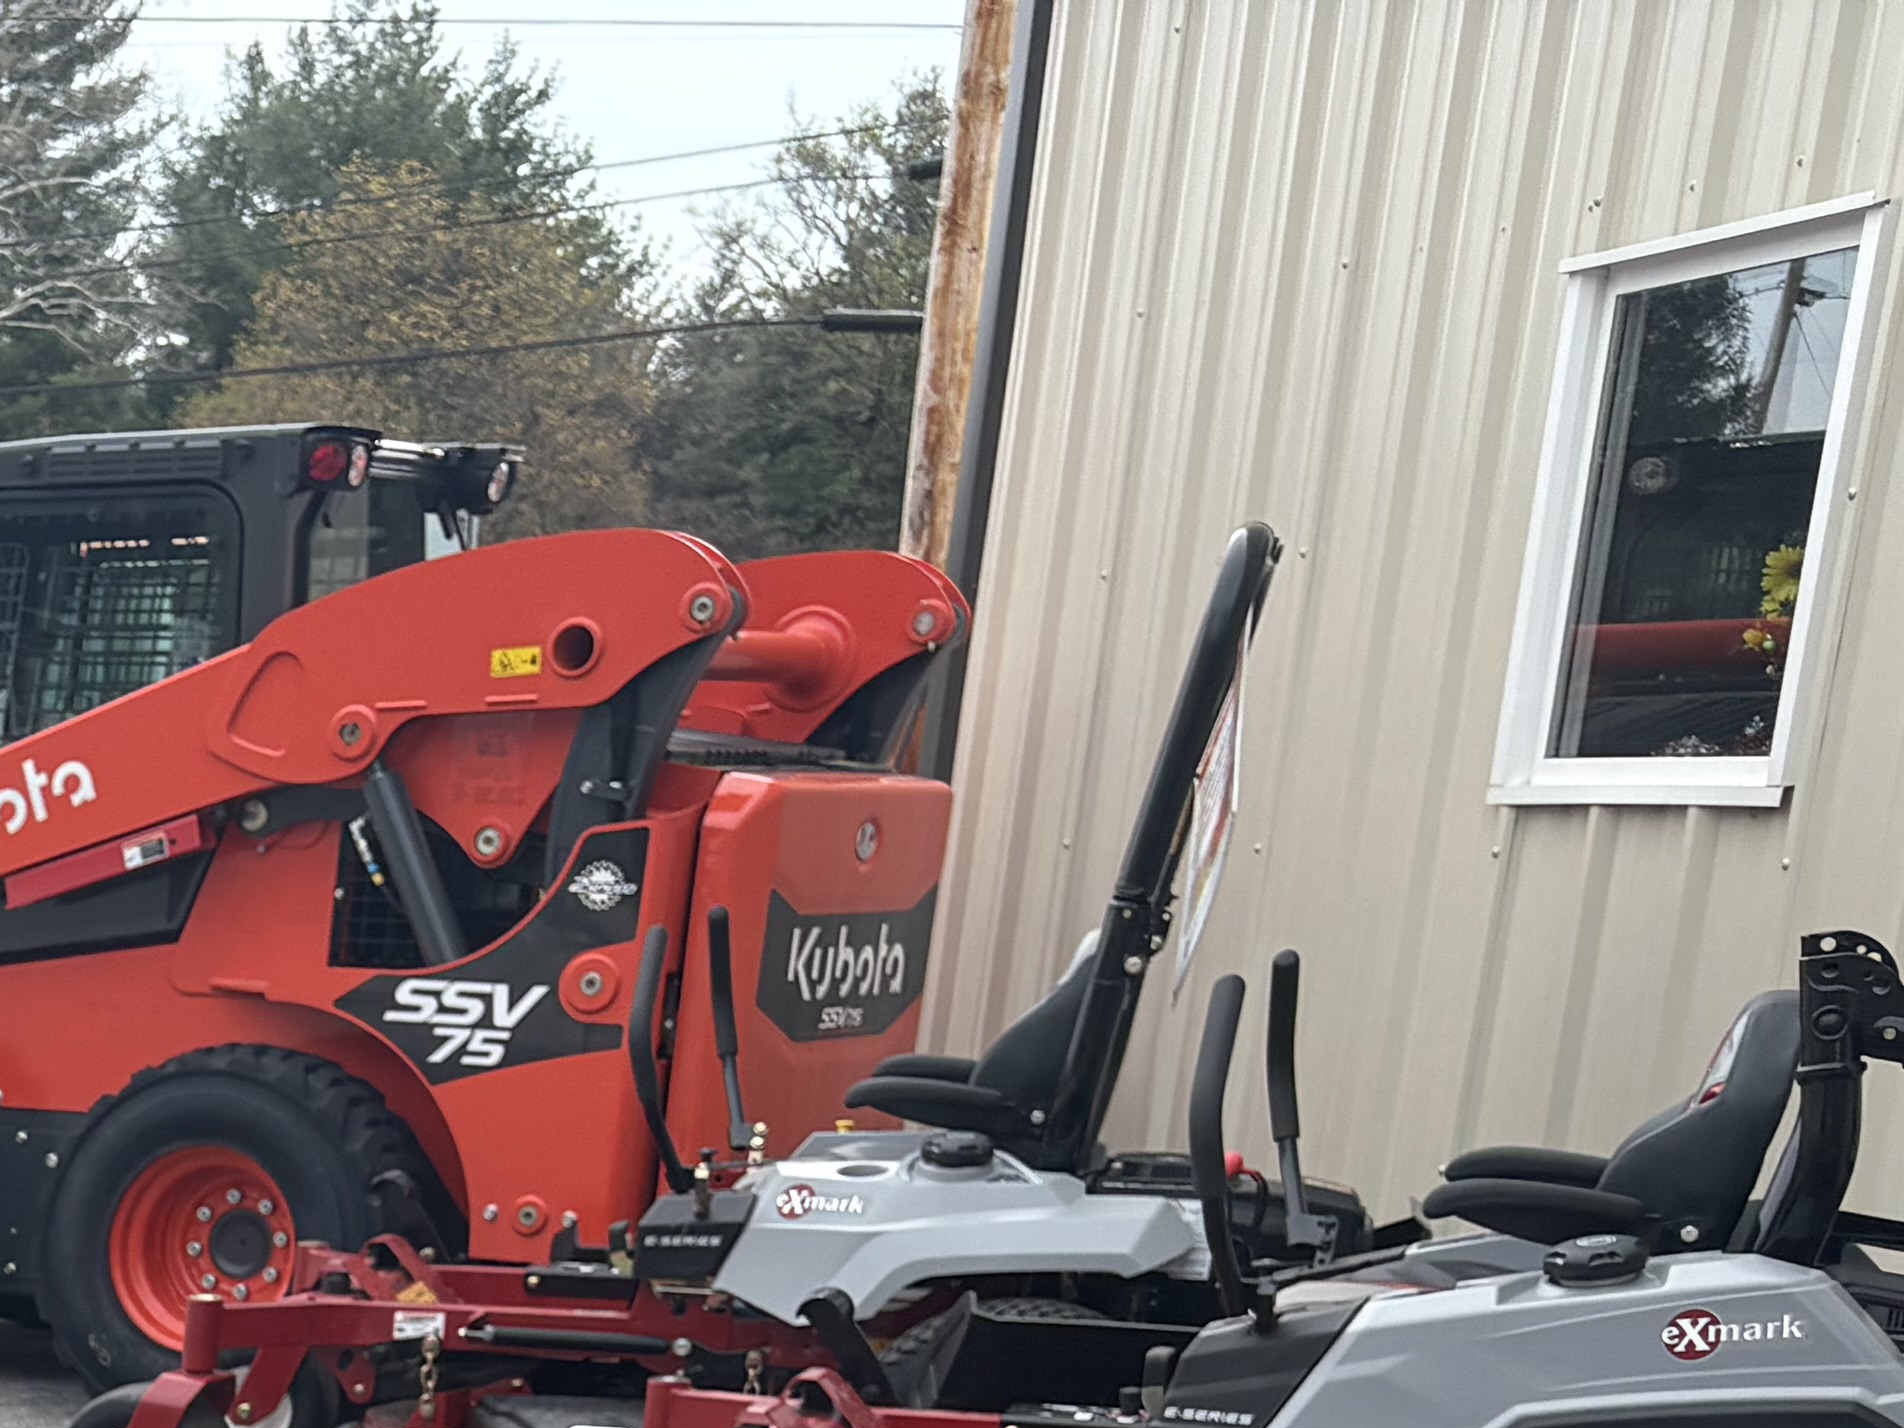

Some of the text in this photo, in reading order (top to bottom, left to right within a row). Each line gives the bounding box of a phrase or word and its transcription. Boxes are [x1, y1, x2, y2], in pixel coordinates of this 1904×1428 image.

[787, 923, 905, 1001] Kubota
[382, 978, 551, 1028] SSV
[426, 1027, 512, 1067] 75
[1661, 1314, 1806, 1352] eXmark
[1163, 1406, 1254, 1426] E-SERIES
